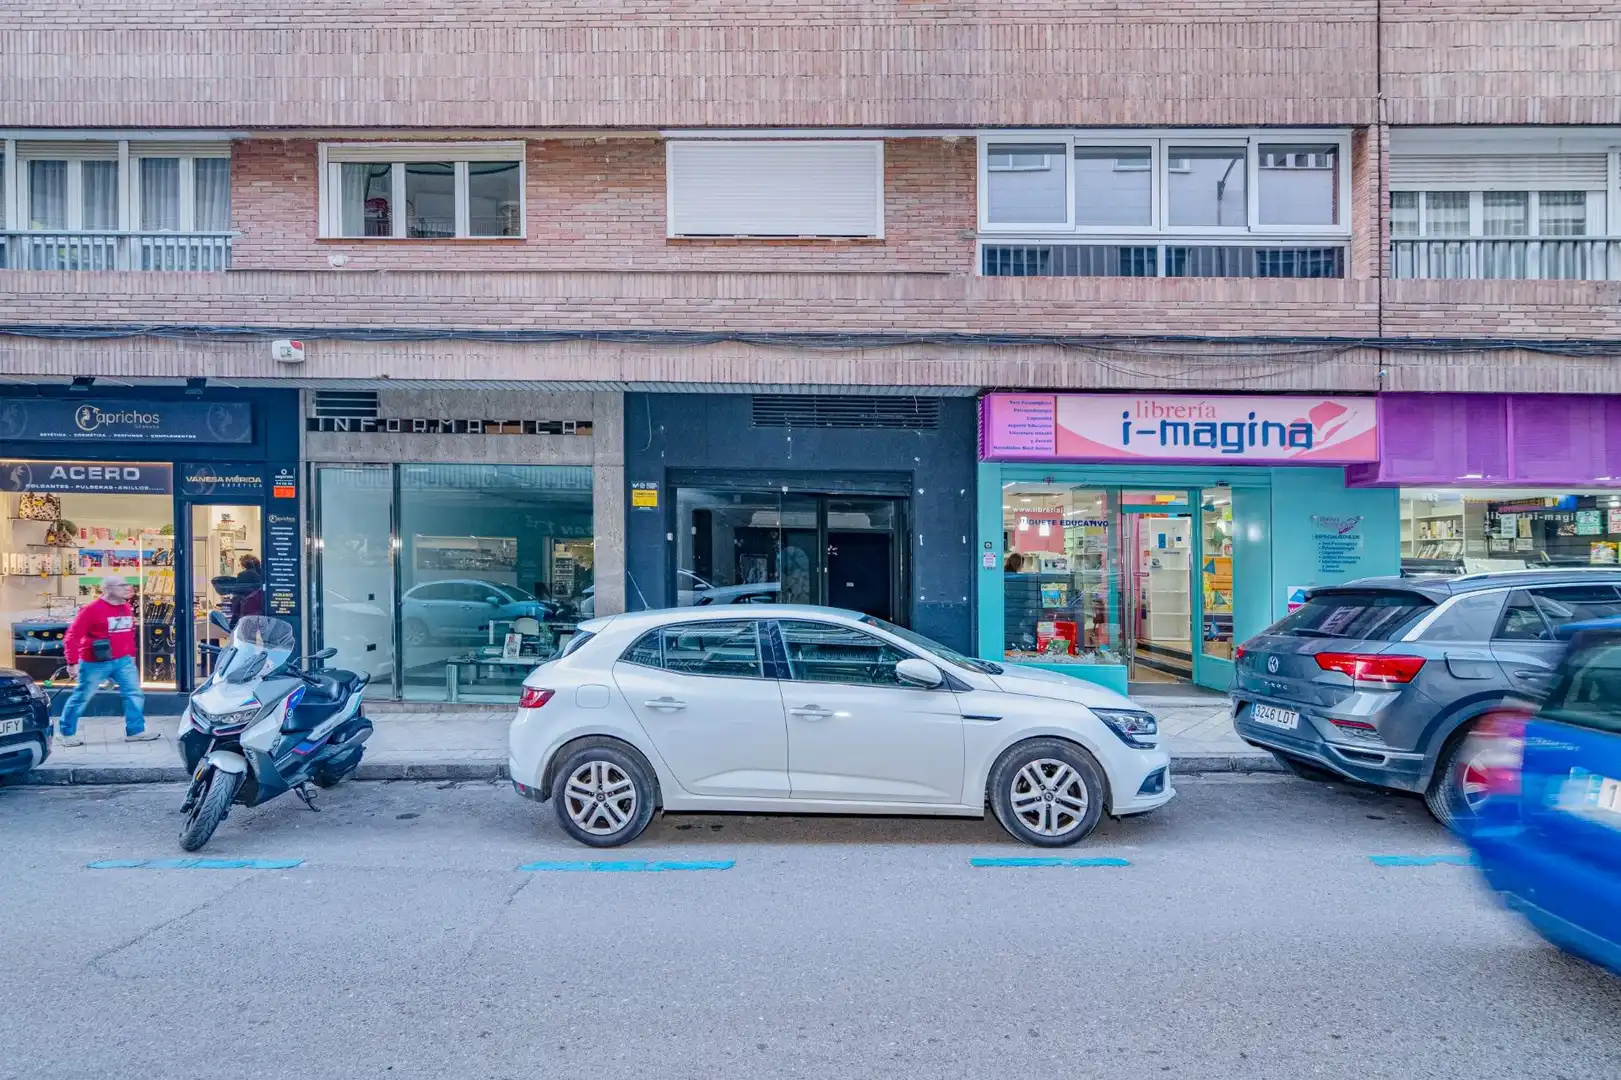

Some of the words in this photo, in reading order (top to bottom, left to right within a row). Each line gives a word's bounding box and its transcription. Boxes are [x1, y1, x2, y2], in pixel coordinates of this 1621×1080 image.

[75, 404, 160, 431] Caprichos
[1136, 400, 1216, 419] librería
[318, 417, 577, 434] INFORMATICA
[1122, 411, 1313, 454] i-magina
[50, 466, 140, 481] ACERO
[225, 475, 262, 483] MÉRIDA
[1060, 519, 1109, 527] EDUCATIVO
[1255, 705, 1276, 721] 3246
[1277, 710, 1296, 726] LDT
